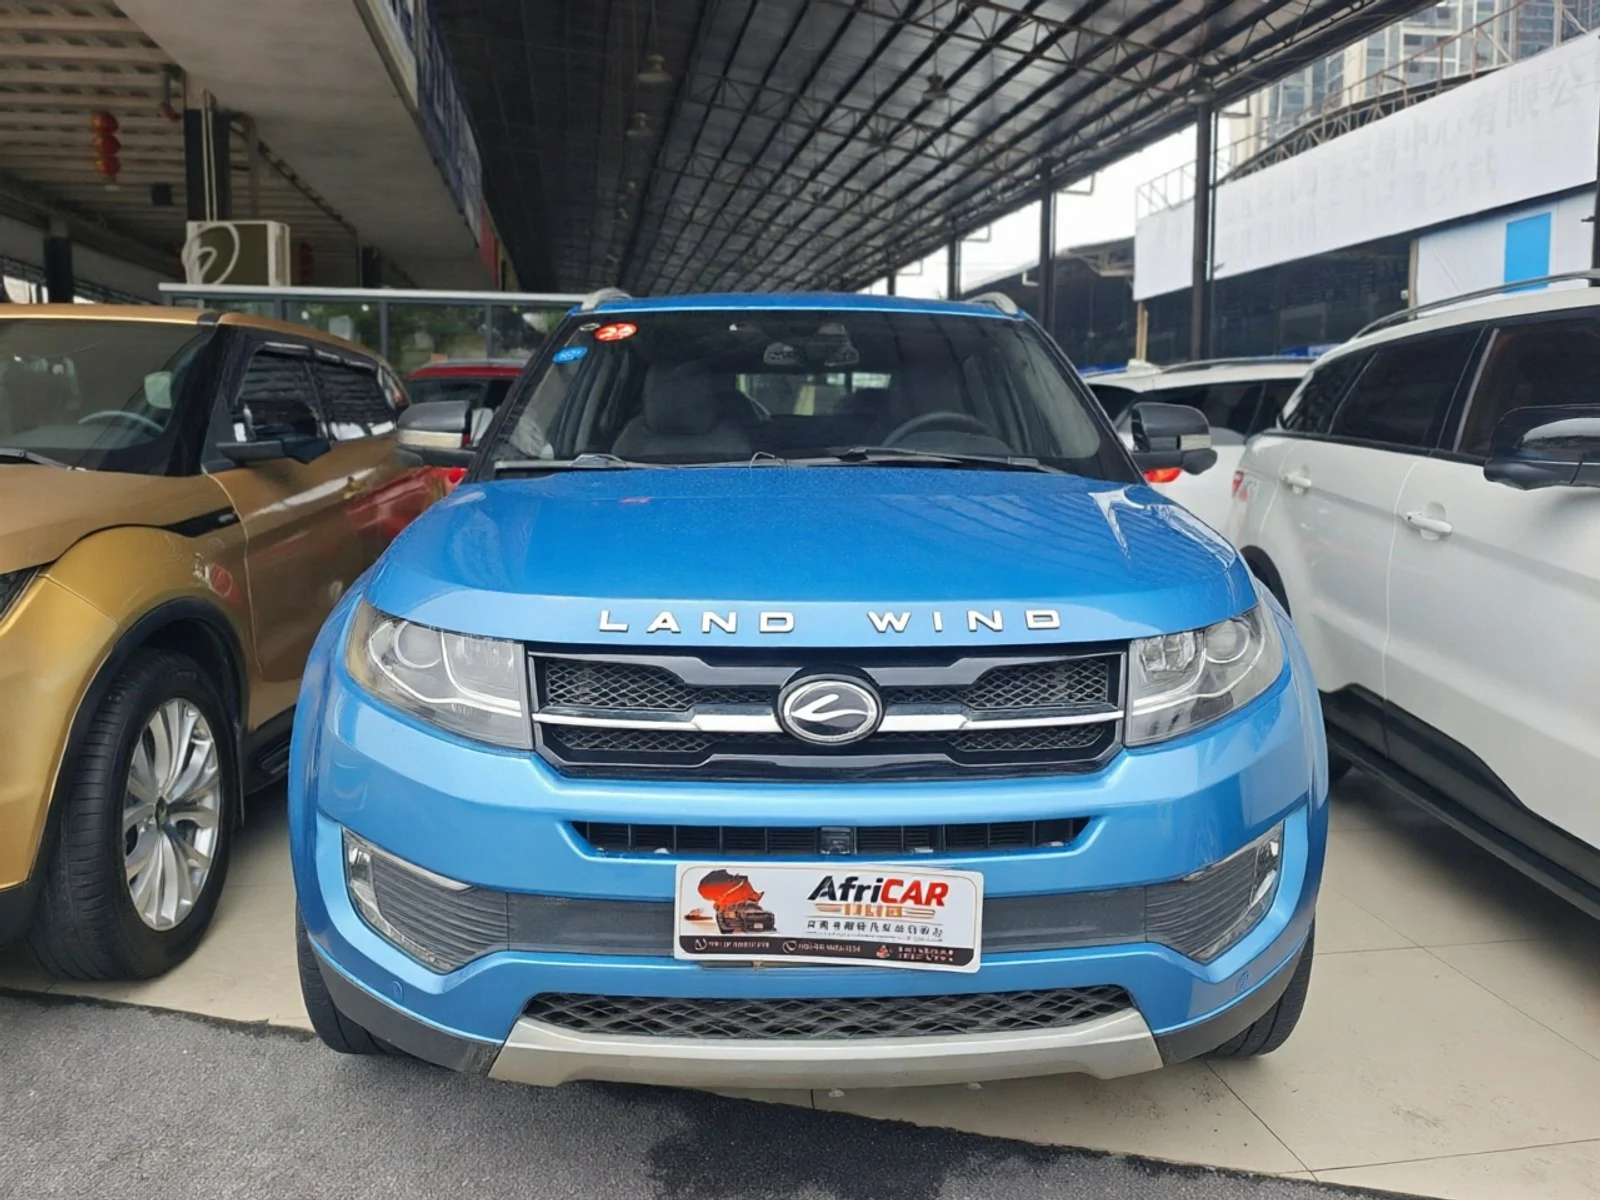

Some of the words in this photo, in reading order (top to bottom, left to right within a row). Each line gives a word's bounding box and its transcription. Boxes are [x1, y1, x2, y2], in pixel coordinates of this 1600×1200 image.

[599, 609, 796, 634] LAND
[867, 608, 1061, 633] WIND
[808, 875, 949, 907] AfriCAR
